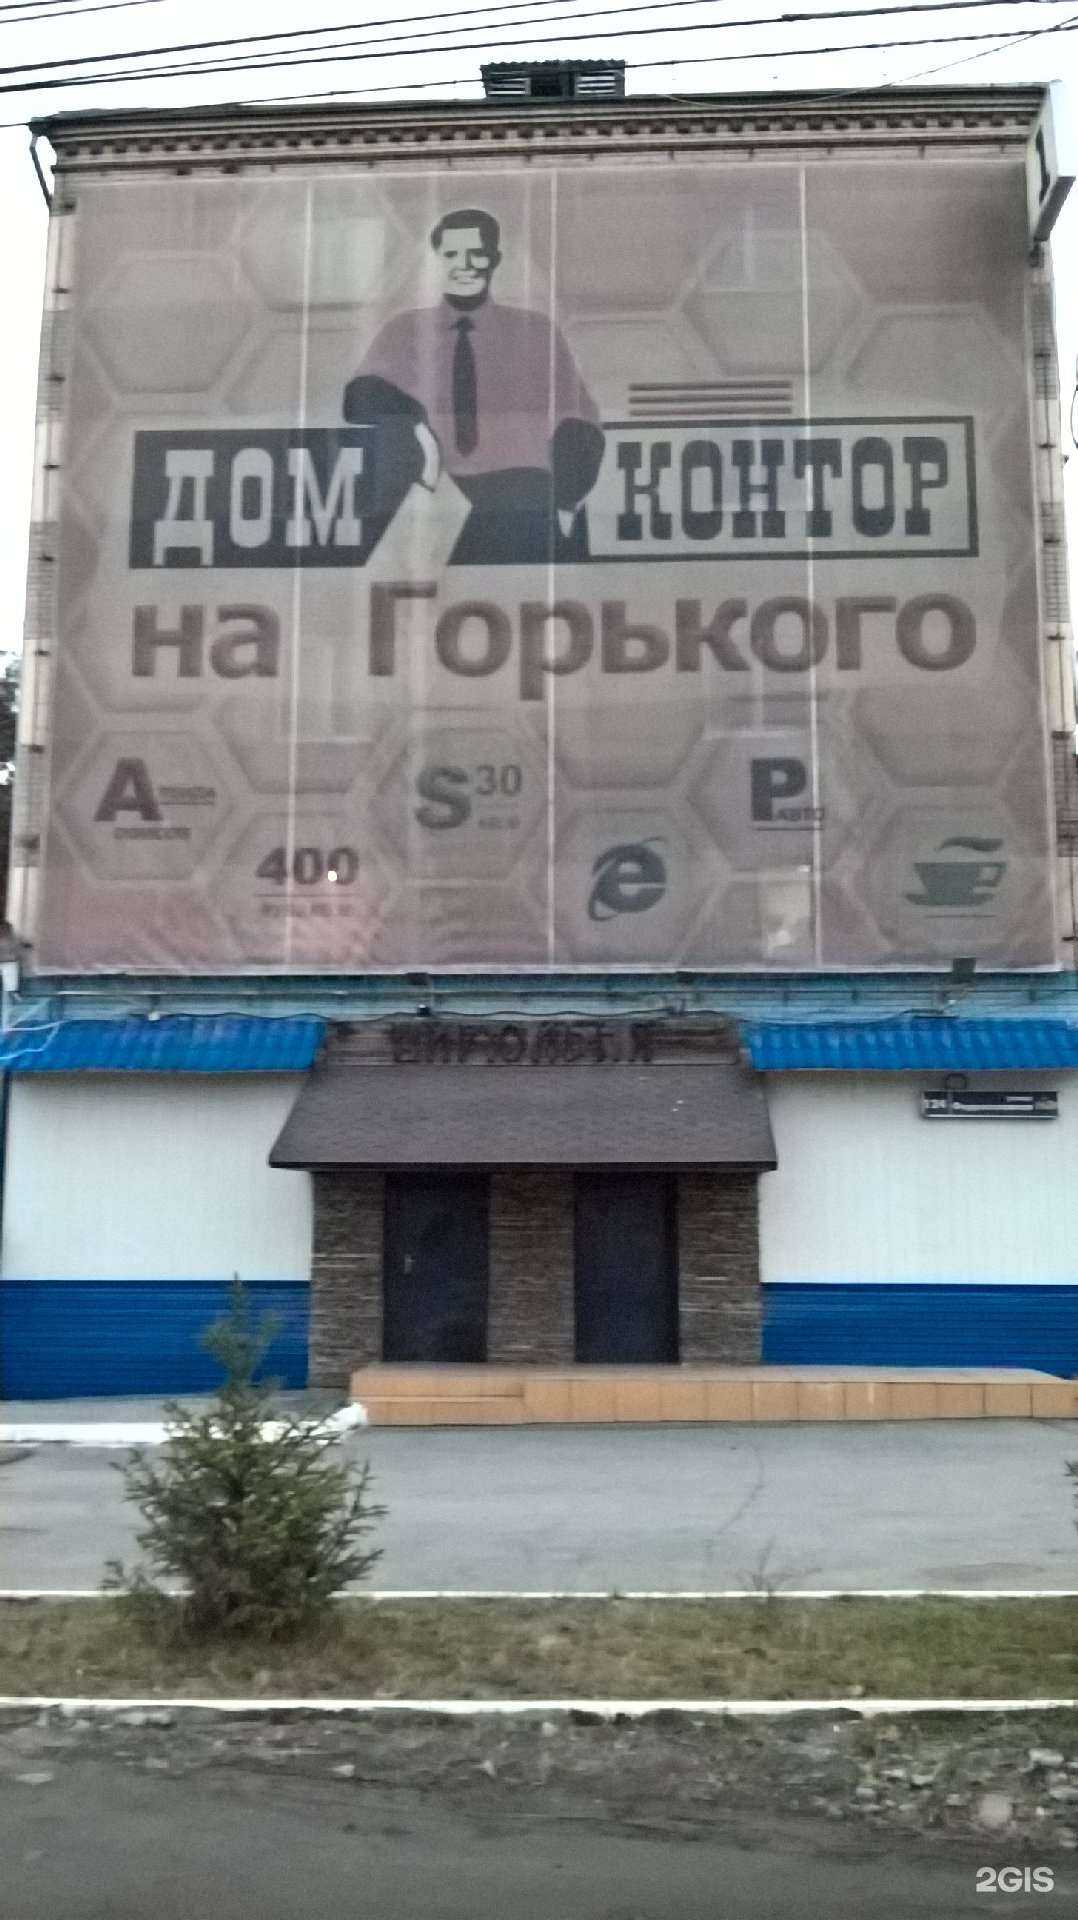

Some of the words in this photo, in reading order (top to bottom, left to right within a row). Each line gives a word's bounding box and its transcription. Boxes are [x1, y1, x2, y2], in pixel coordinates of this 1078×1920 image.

[153, 446, 364, 567] ДОМ
[616, 436, 949, 541] КОНТОР
[131, 601, 281, 679] на
[368, 580, 977, 701] Горького
[255, 847, 360, 886] 400
